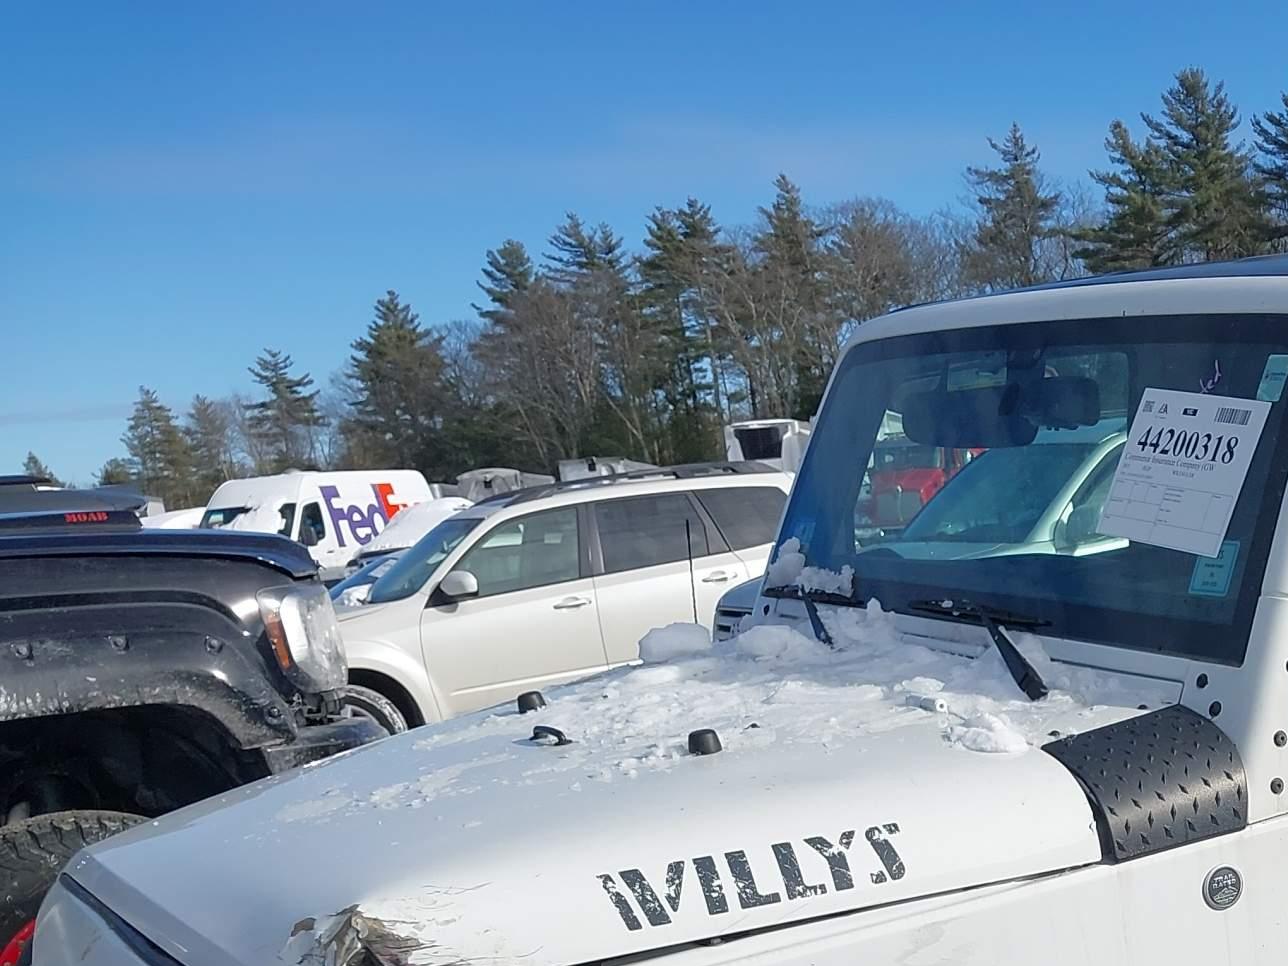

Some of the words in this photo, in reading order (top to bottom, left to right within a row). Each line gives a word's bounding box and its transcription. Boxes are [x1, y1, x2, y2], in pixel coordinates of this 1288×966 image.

[1137, 426, 1238, 464] 44200318
[319, 483, 416, 547] FedE
[596, 823, 906, 931] WILLYS
